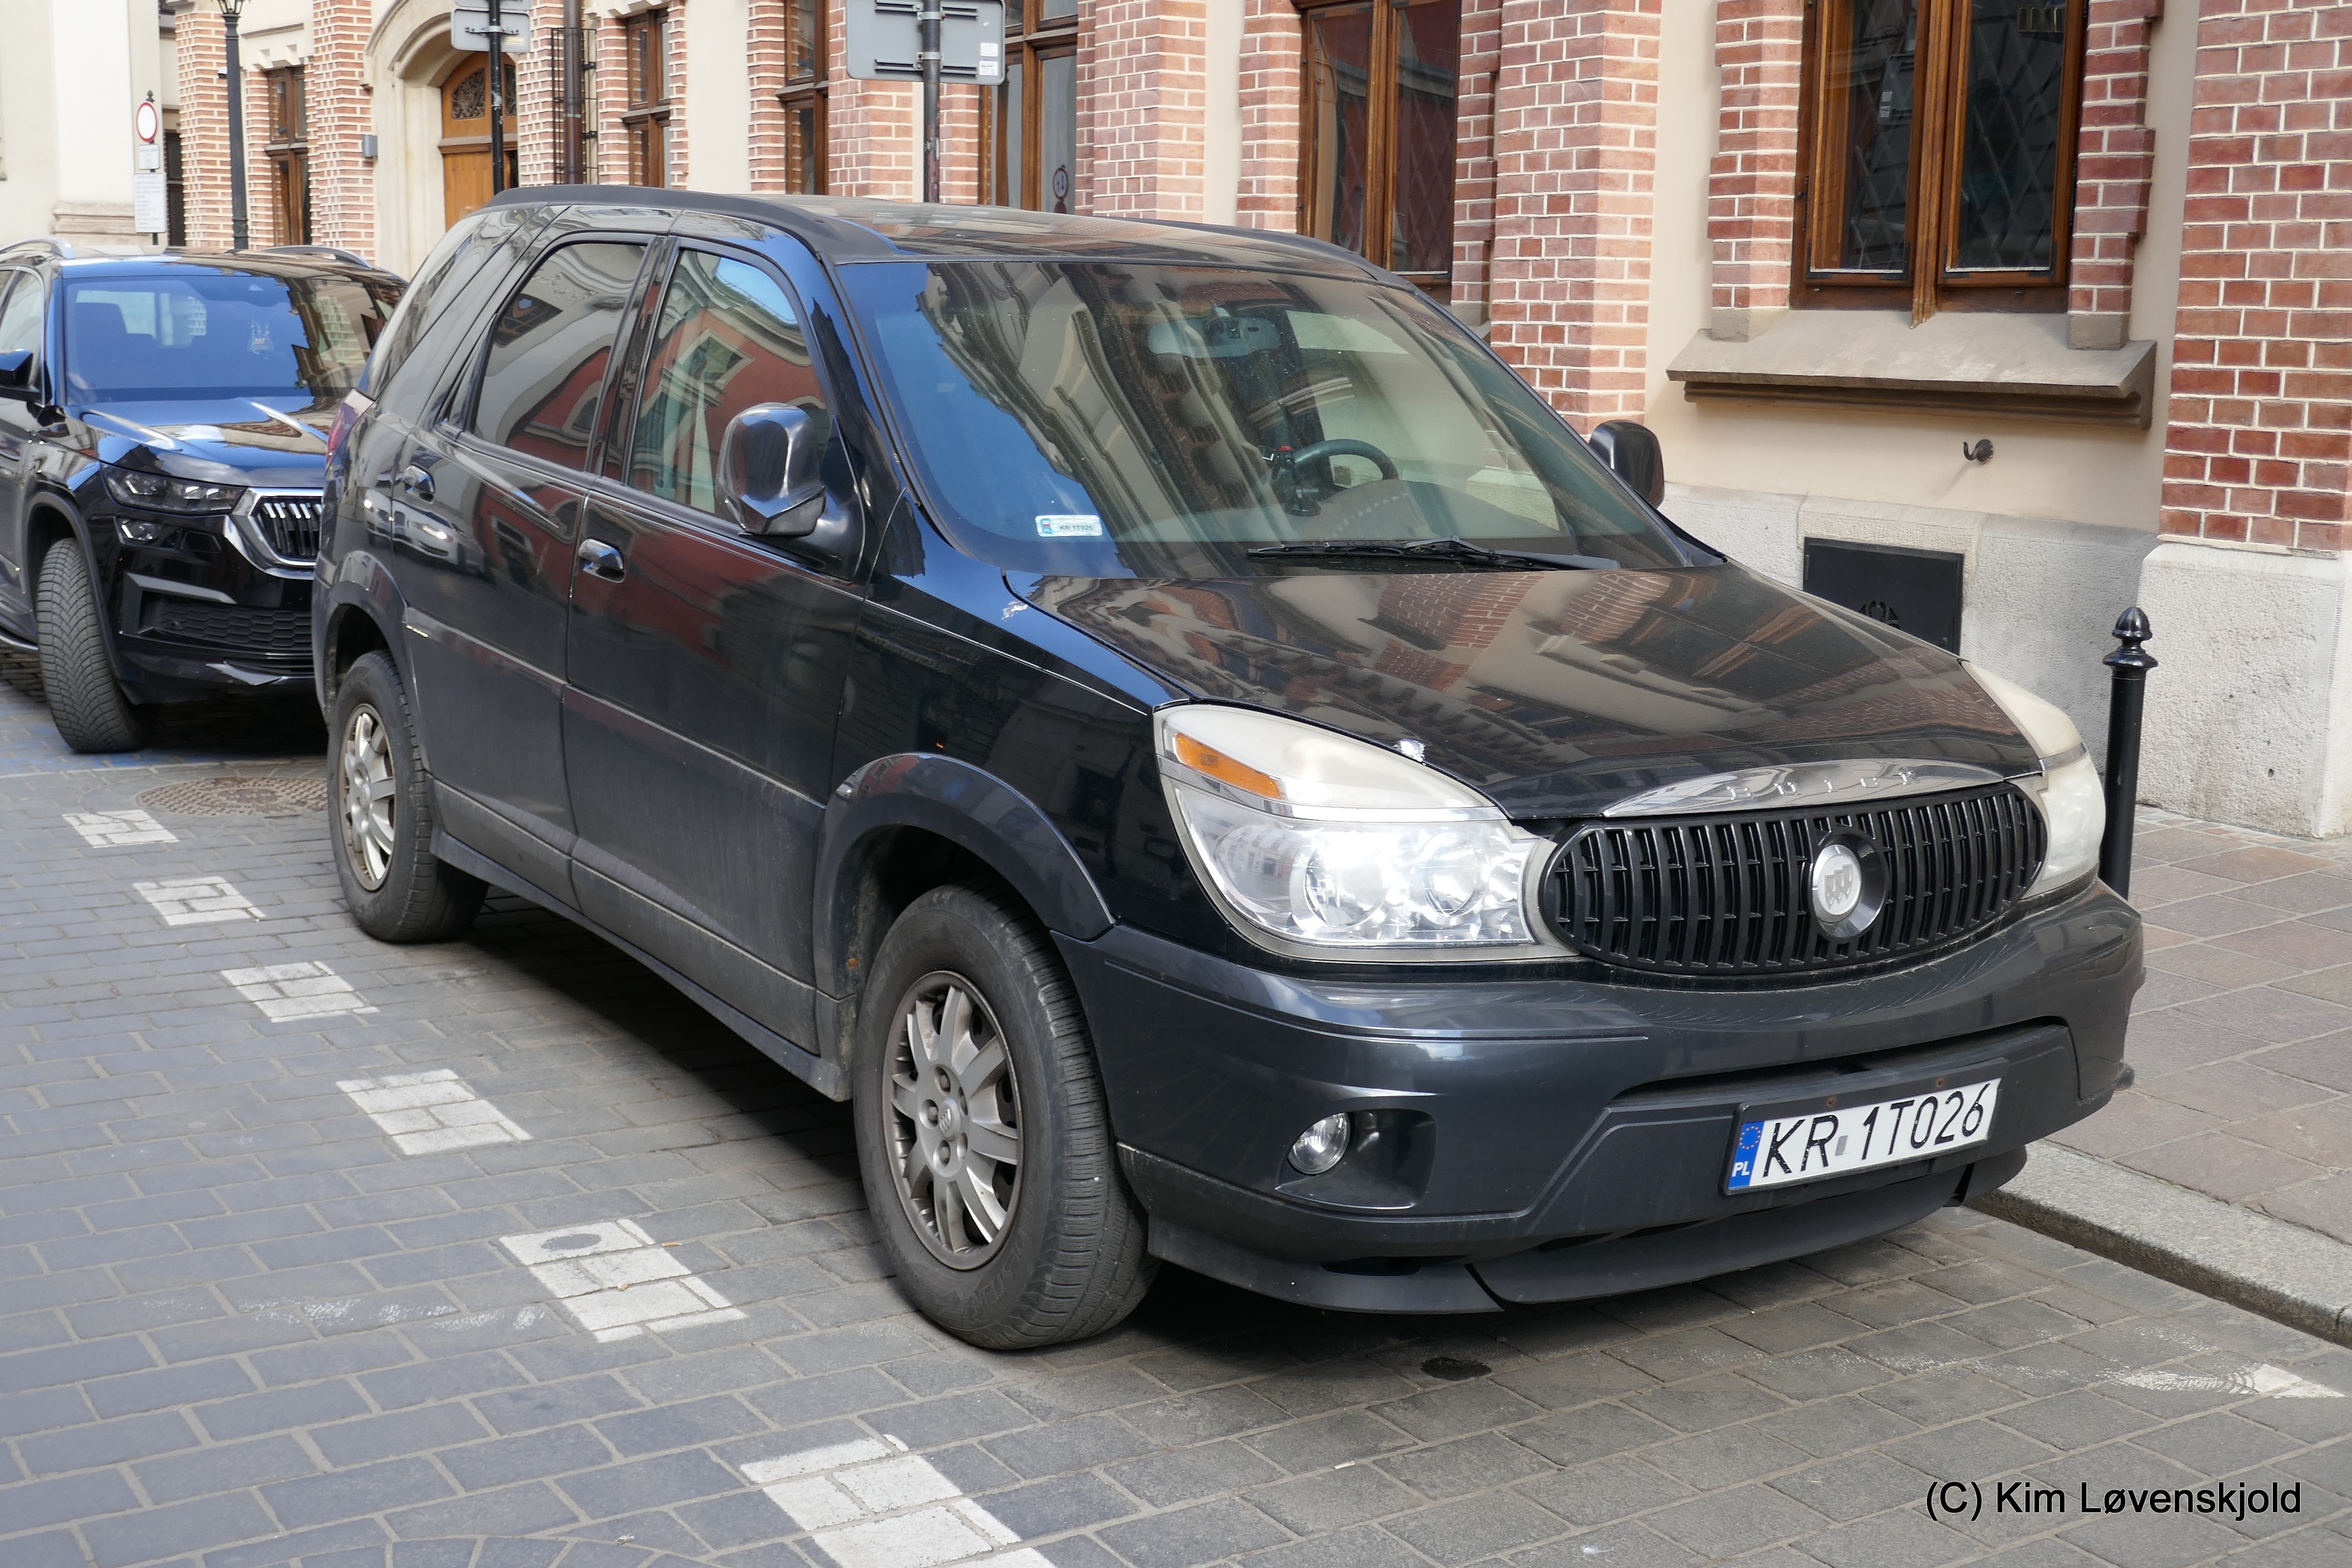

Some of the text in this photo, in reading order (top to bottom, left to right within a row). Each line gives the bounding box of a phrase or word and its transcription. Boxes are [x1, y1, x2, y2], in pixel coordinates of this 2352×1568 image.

[1727, 771, 1920, 800] BUICK
[1763, 1084, 1991, 1177] KR 1T026
[1732, 1161, 1750, 1177] PL
